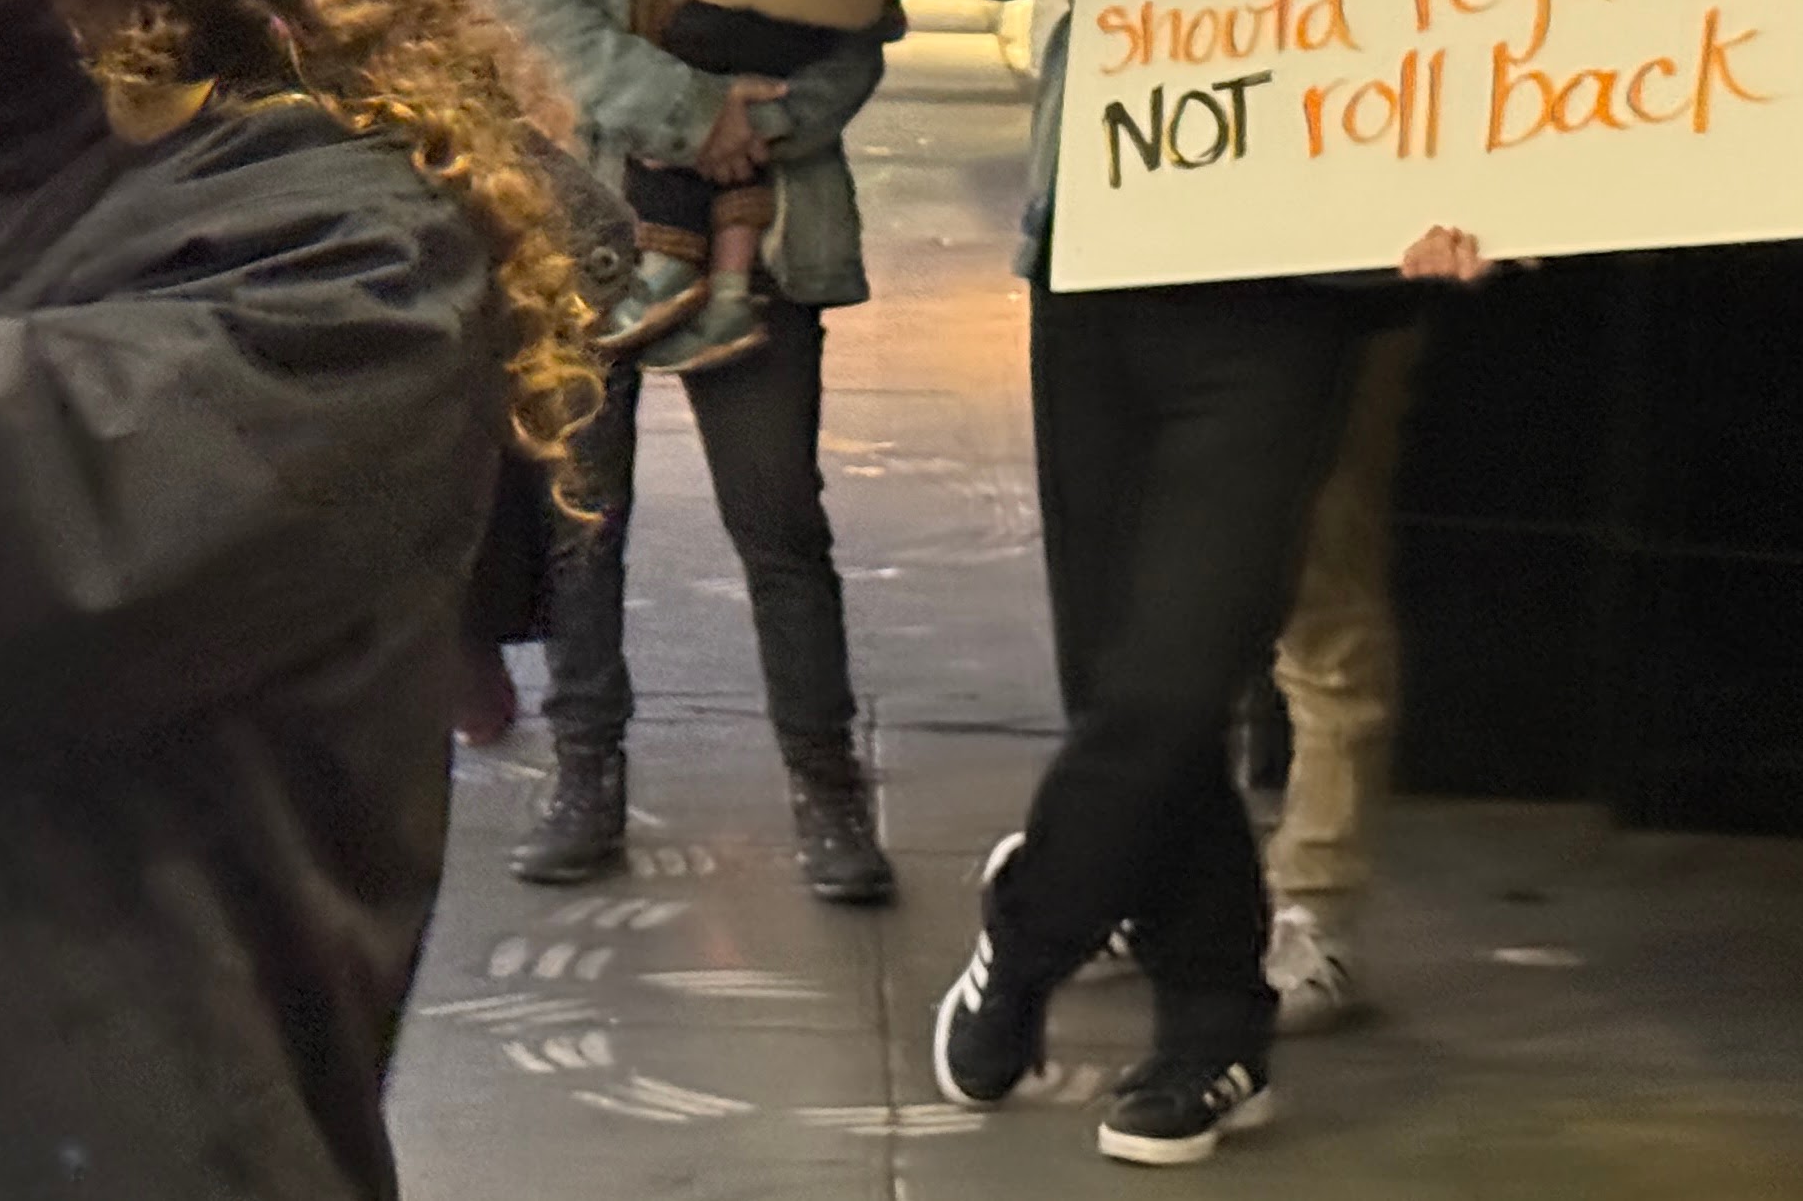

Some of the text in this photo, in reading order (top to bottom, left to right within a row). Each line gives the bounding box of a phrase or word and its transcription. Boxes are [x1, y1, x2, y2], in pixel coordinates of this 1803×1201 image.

[1102, 8, 1776, 189] NOT roll back
